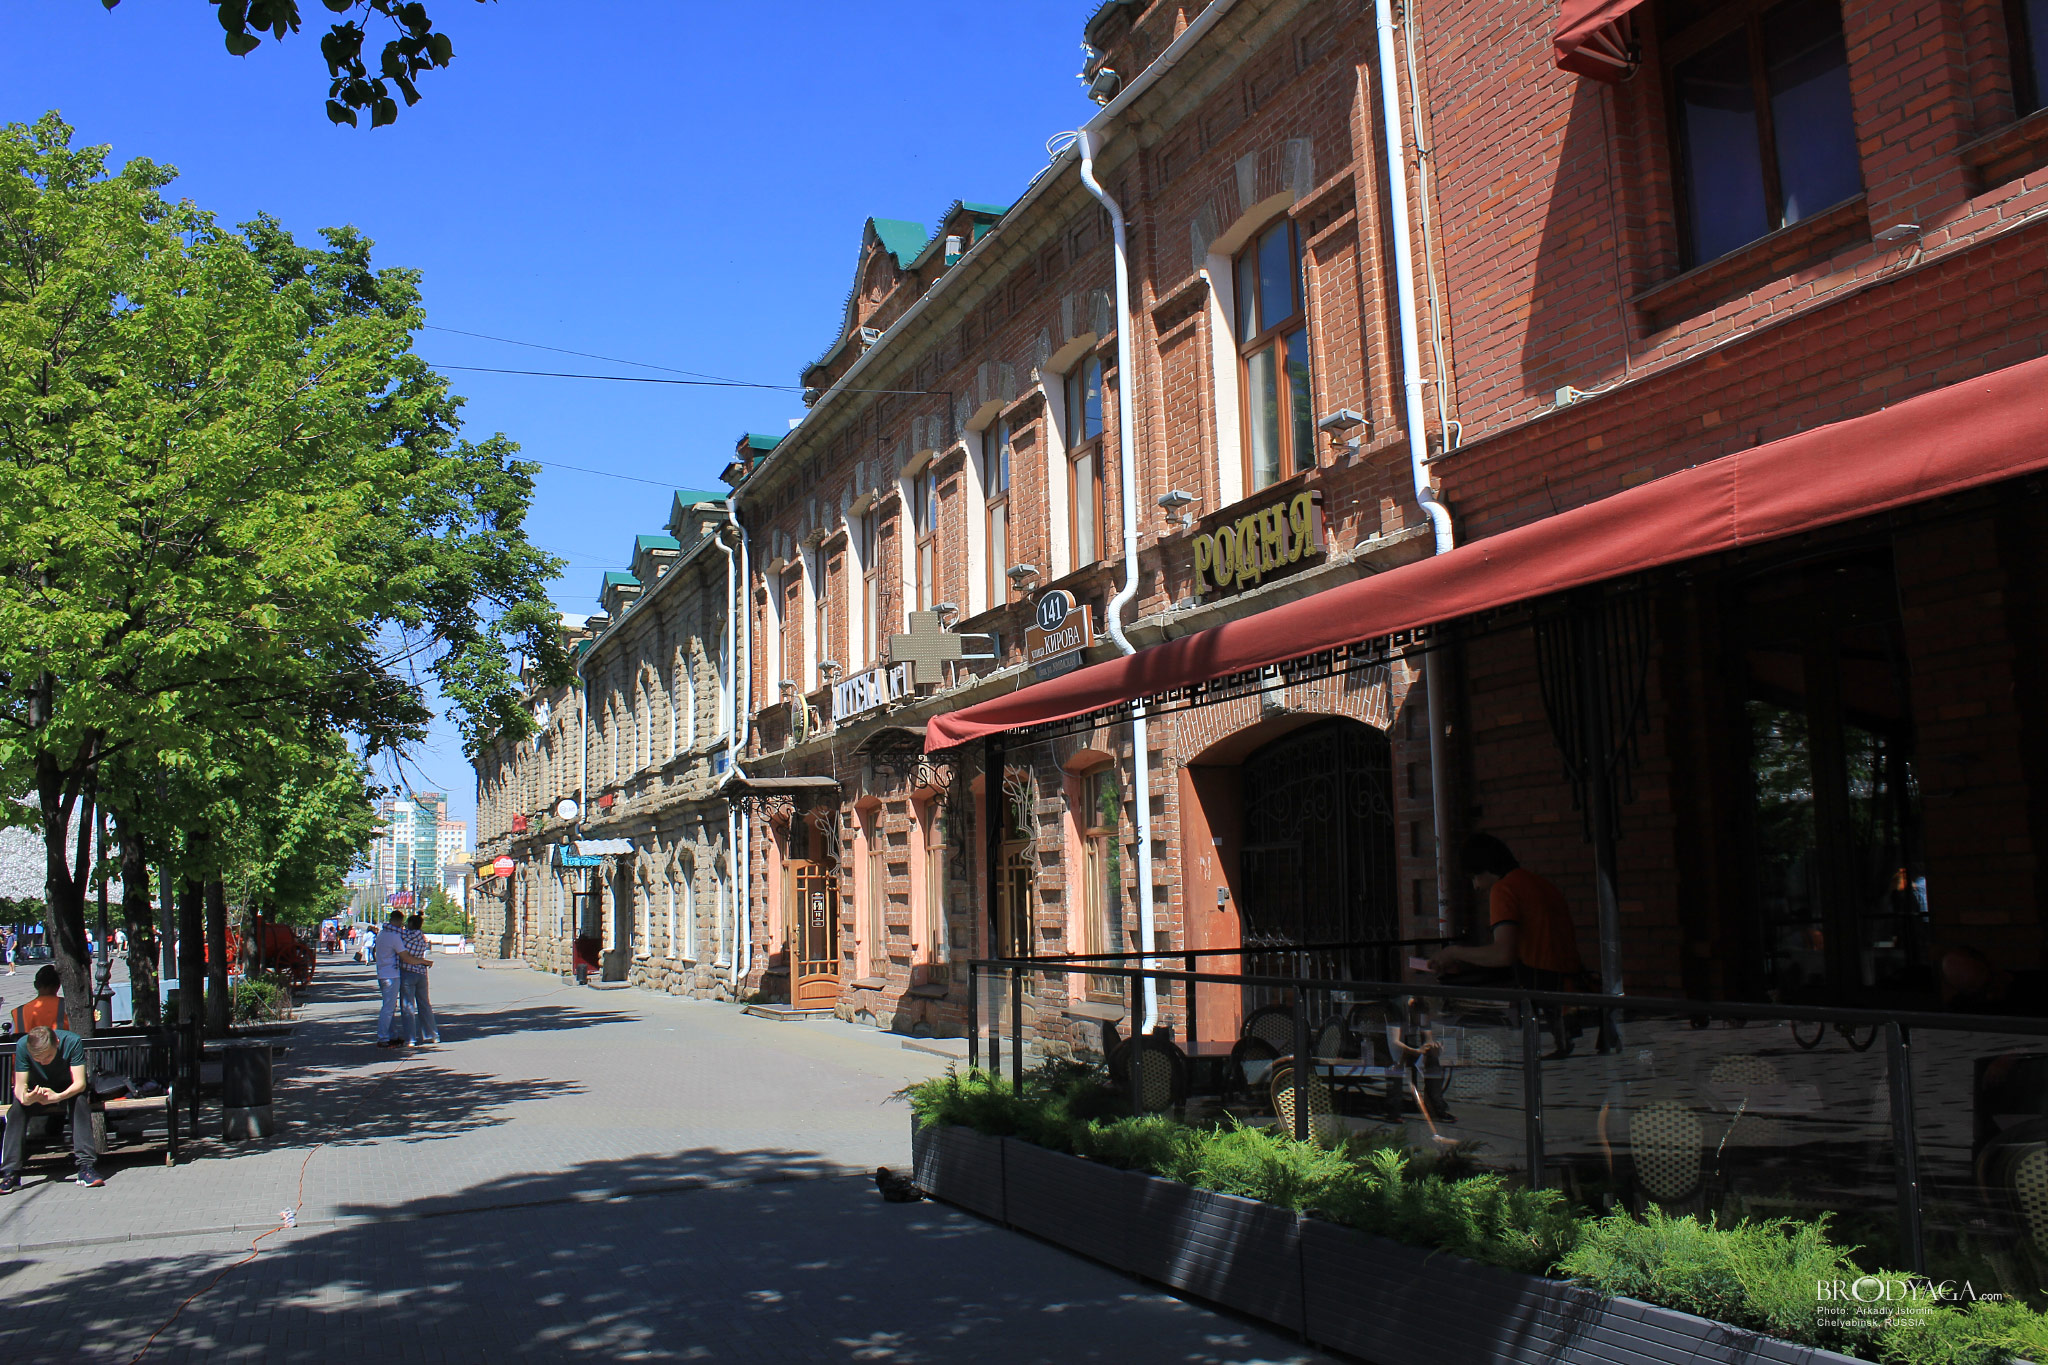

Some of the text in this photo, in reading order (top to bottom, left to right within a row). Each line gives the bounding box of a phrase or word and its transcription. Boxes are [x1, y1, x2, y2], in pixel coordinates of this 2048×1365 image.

[1192, 490, 1317, 595] РОДНЯ
[1042, 596, 1063, 626] 141
[1031, 625, 1081, 663] улица КИРОВА
[832, 668, 887, 722] АПТЕКА
